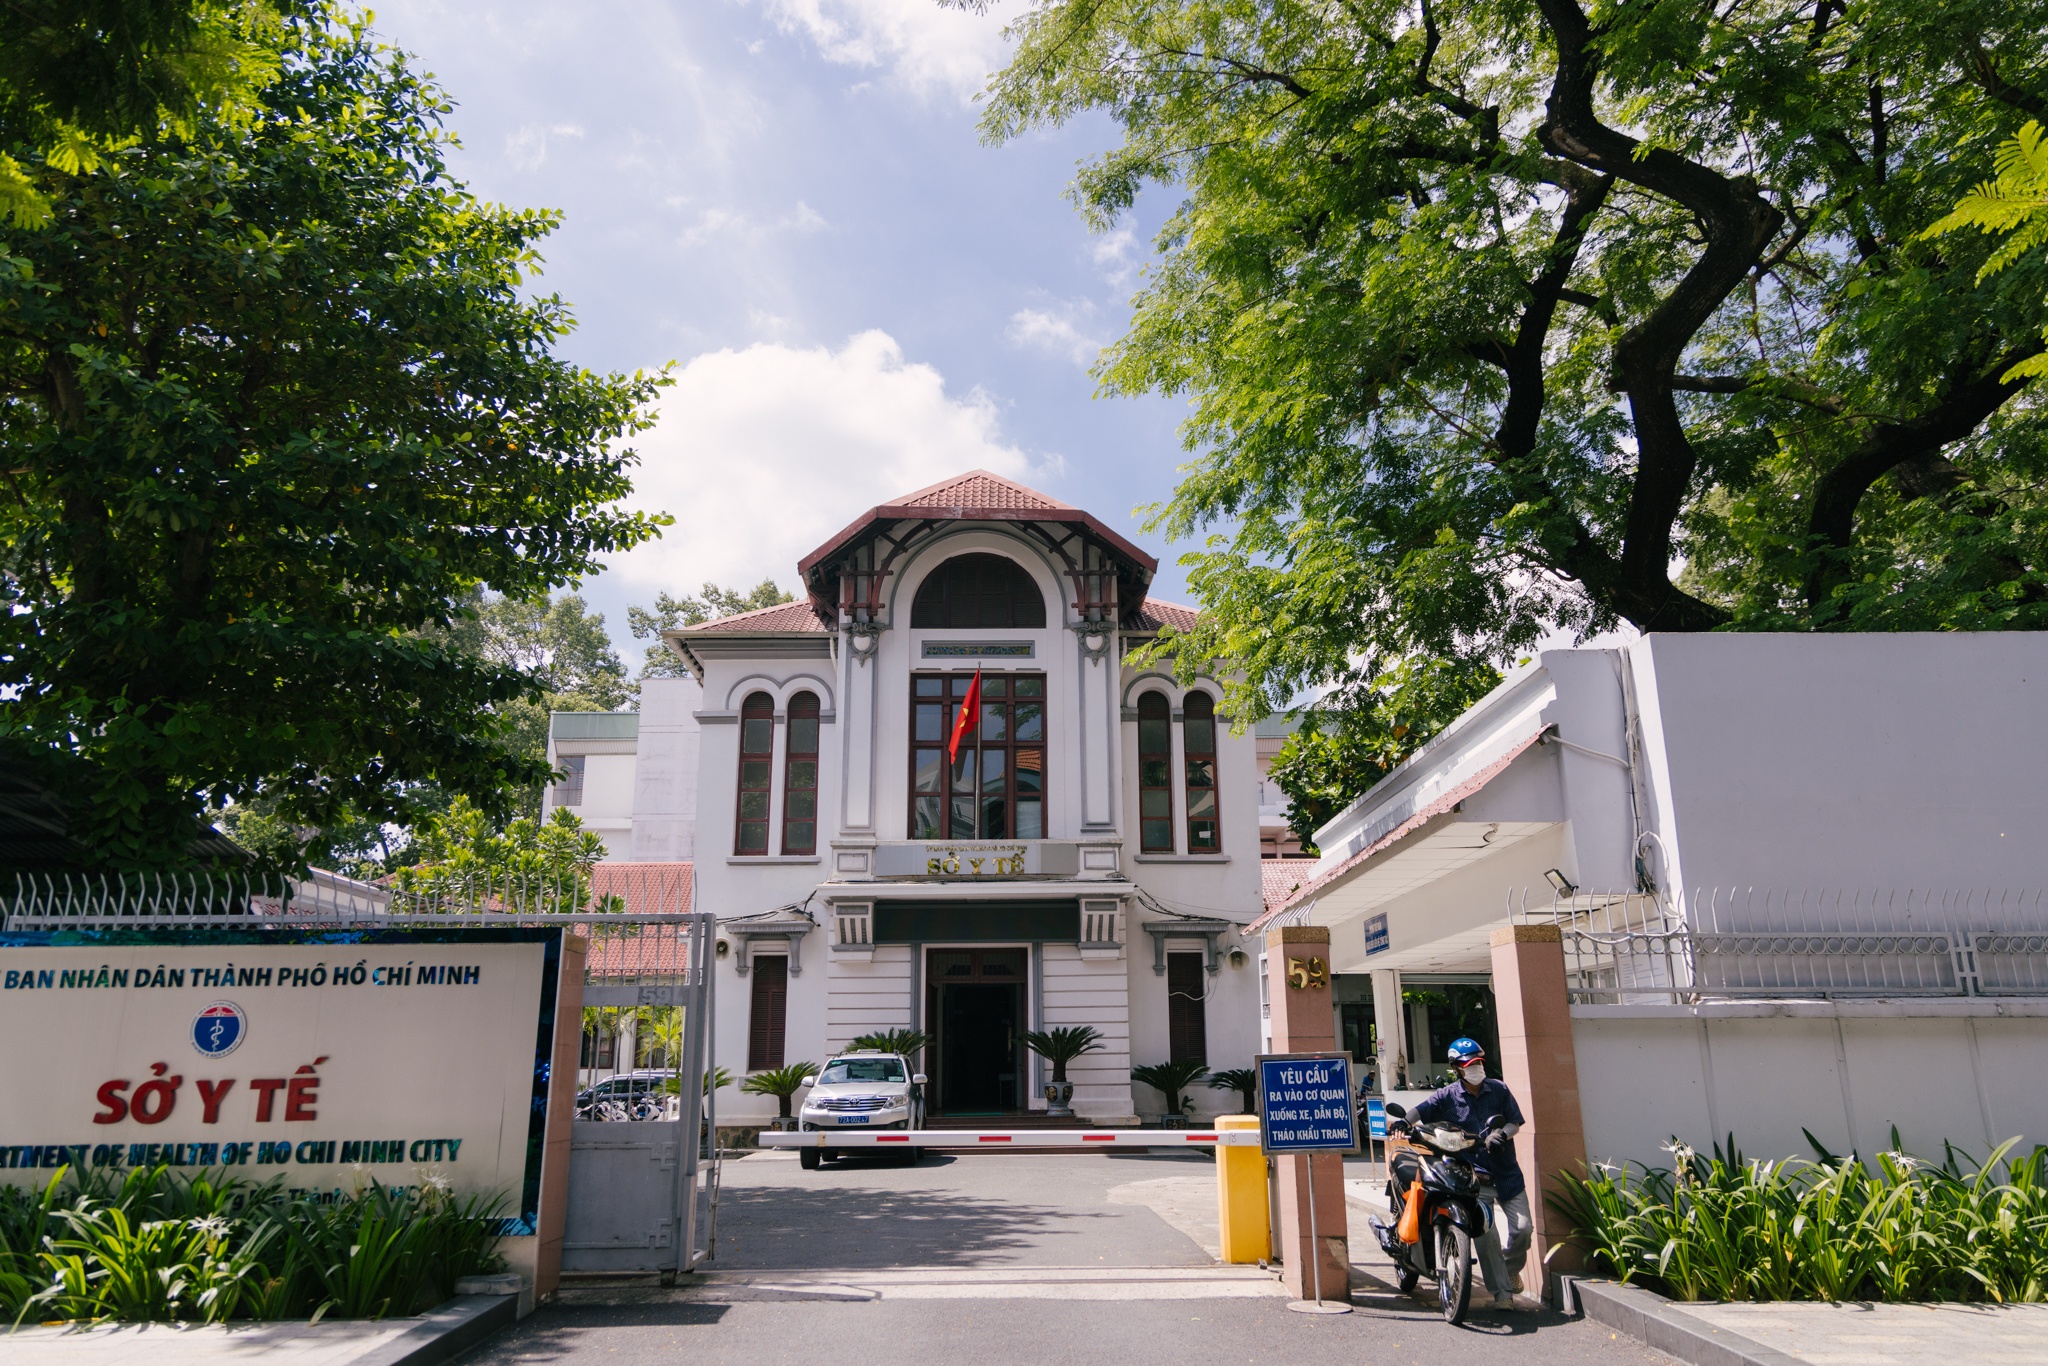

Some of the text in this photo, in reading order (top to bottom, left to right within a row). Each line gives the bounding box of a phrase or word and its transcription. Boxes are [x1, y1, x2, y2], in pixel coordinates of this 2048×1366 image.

[927, 850, 1026, 874] SỞ Y TẾ
[4, 959, 481, 989] BAN NHÂN DÂN THÀNH PHỐ HỒ CHÍ MINH
[1287, 956, 1328, 989] 59
[639, 986, 673, 1005] 59
[1280, 1064, 1329, 1085] YÊU CẦU
[92, 1056, 330, 1125] SỞ Y TẾ
[1269, 1088, 1345, 1102] RA VÀO CƠ QUAN
[1269, 1104, 1348, 1121] XUỐNG XE, DẪN BỘ,
[1272, 1124, 1349, 1141] THÁO KHẨU TRANG
[92, 1144, 125, 1168] OF
[127, 1142, 219, 1167] HEALTH
[222, 1142, 254, 1166] OF
[256, 1141, 292, 1165] HO
[295, 1140, 336, 1164] CHI
[339, 1140, 406, 1164] MINH
[409, 1139, 462, 1163] CITY
